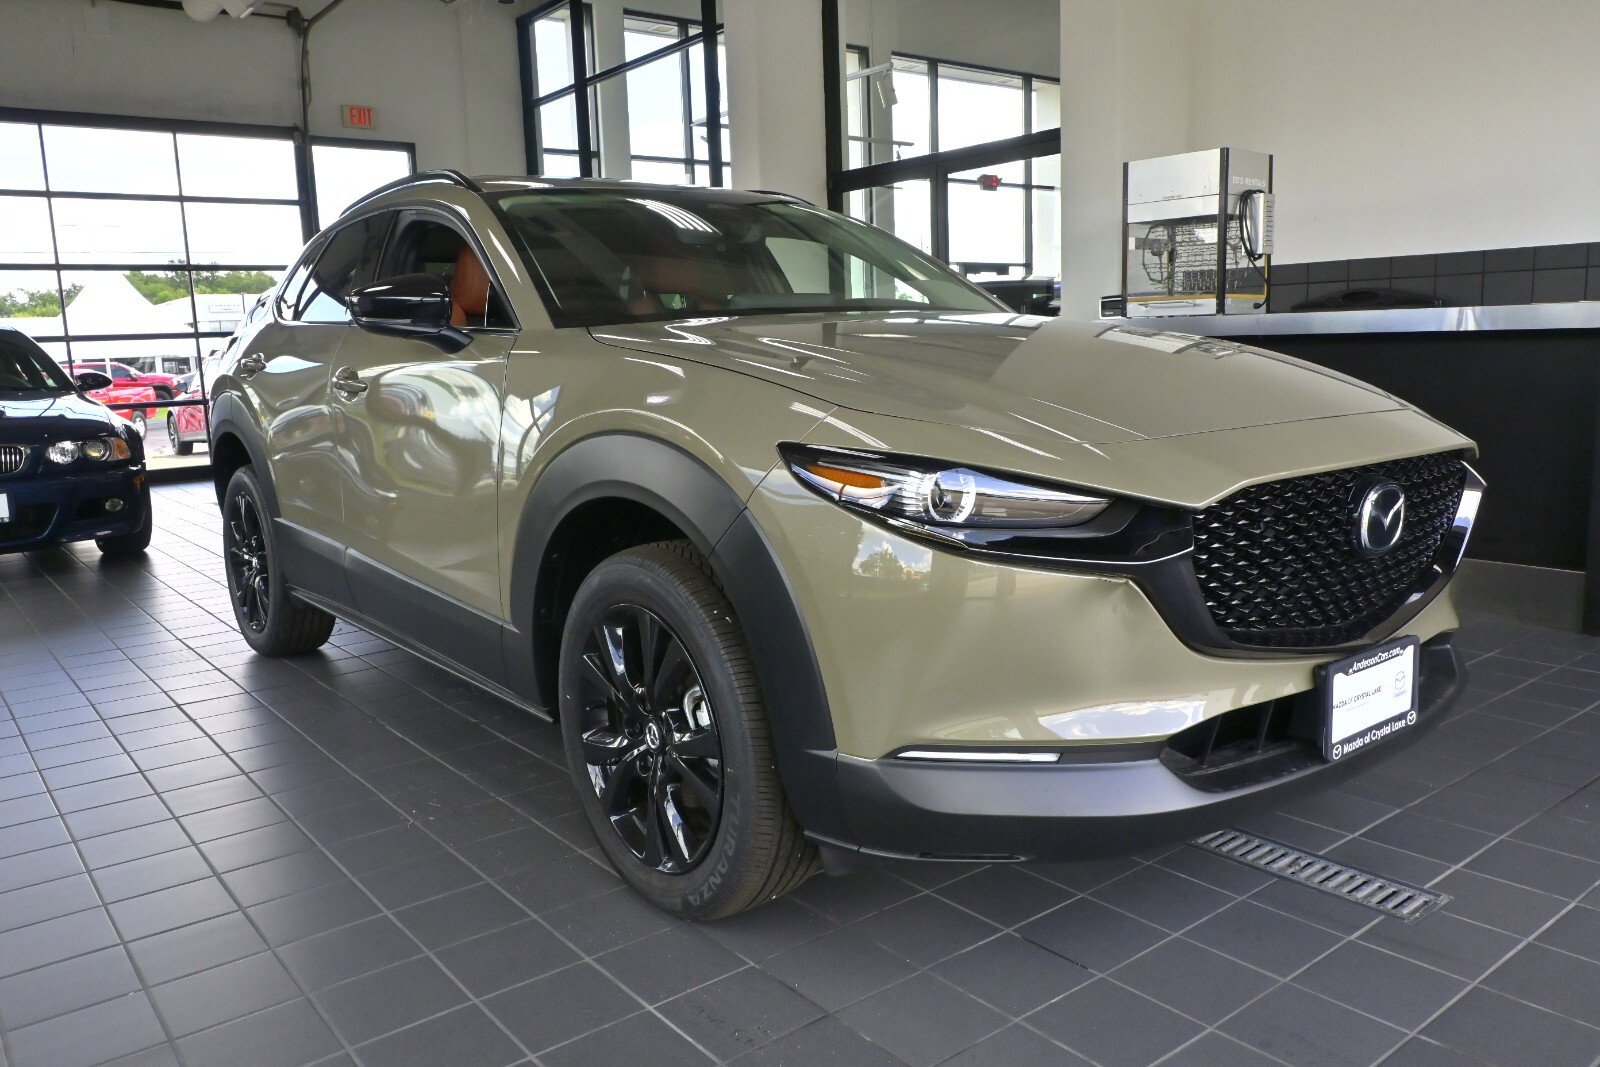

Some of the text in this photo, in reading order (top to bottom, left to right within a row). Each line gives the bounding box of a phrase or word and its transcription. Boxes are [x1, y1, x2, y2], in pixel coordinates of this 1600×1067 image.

[350, 107, 372, 126] EXIT
[1352, 647, 1401, 671] AndersonCars.com
[1343, 719, 1406, 755] Mazda of Crystal Lake
[687, 794, 740, 906] TURANZA
